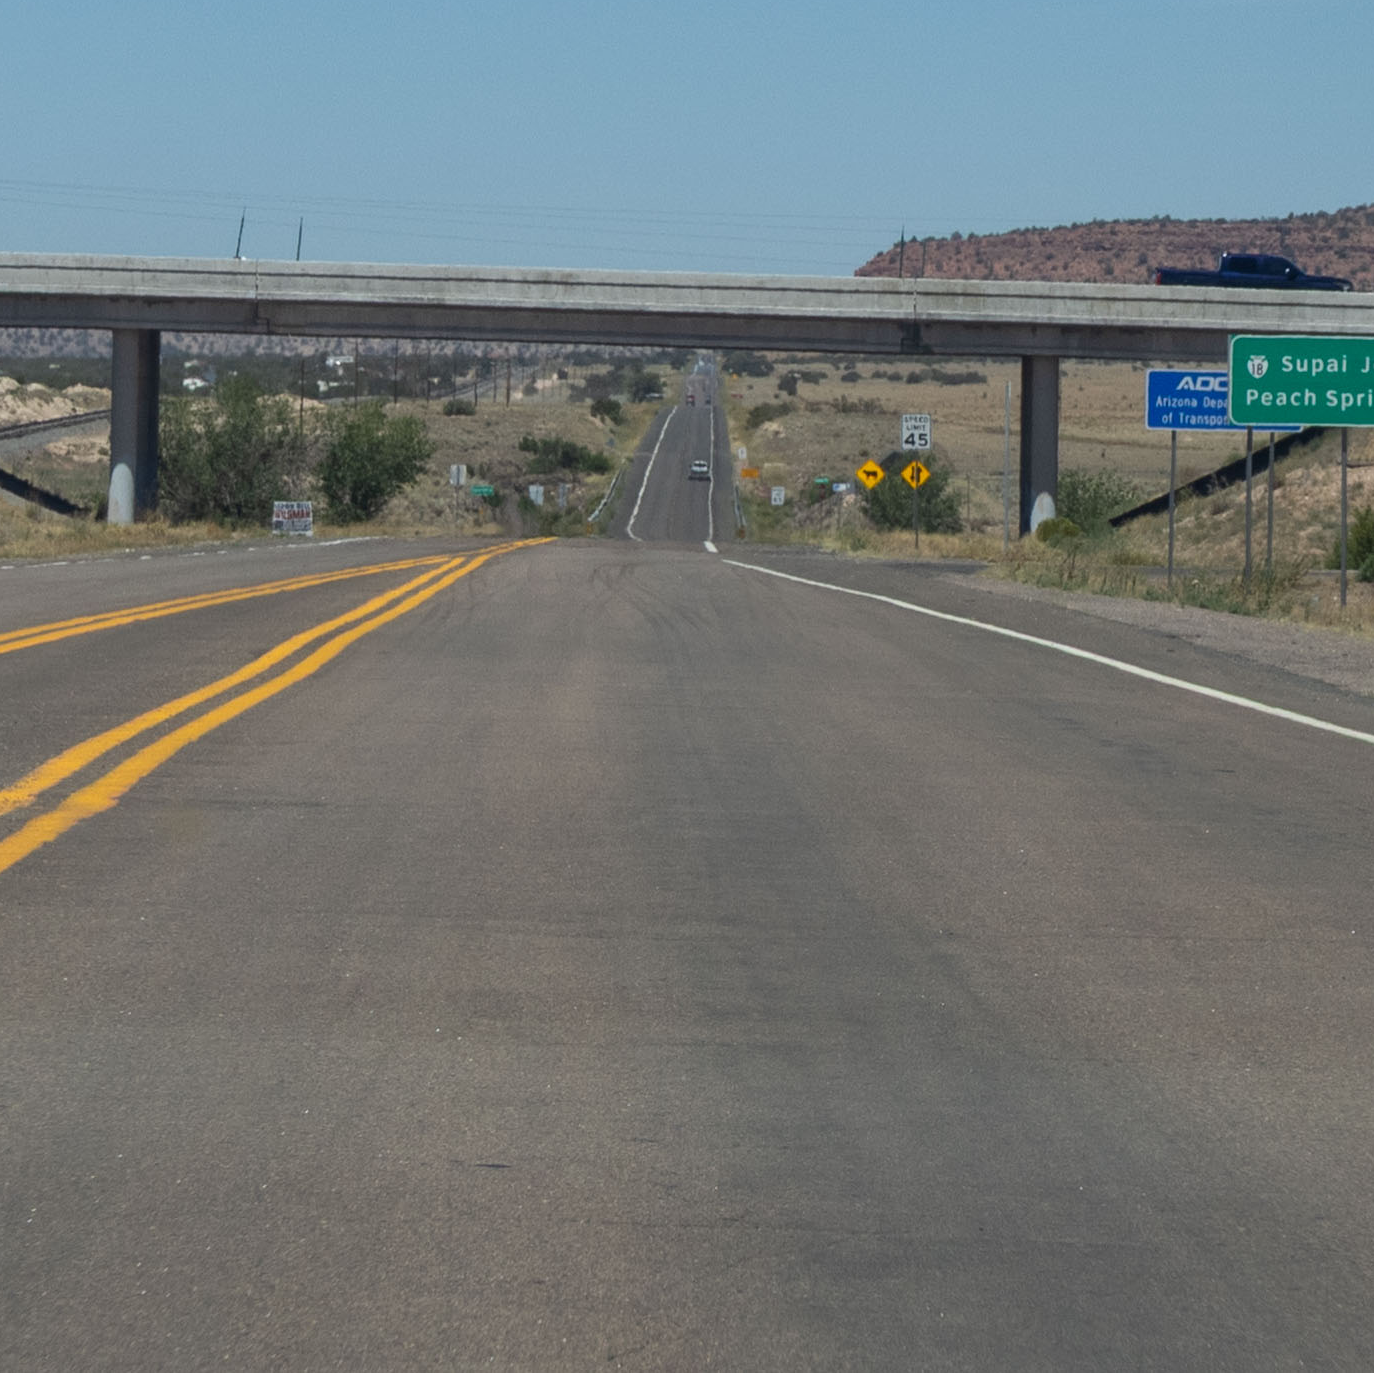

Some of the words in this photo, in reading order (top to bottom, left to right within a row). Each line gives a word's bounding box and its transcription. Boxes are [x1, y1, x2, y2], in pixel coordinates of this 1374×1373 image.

[1251, 362, 1264, 376] 18
[1281, 354, 1347, 377] Supai
[1155, 395, 1198, 408] Arizona
[1246, 388, 1317, 406] Peach
[1161, 412, 1173, 425] of
[904, 432, 928, 447] 45
